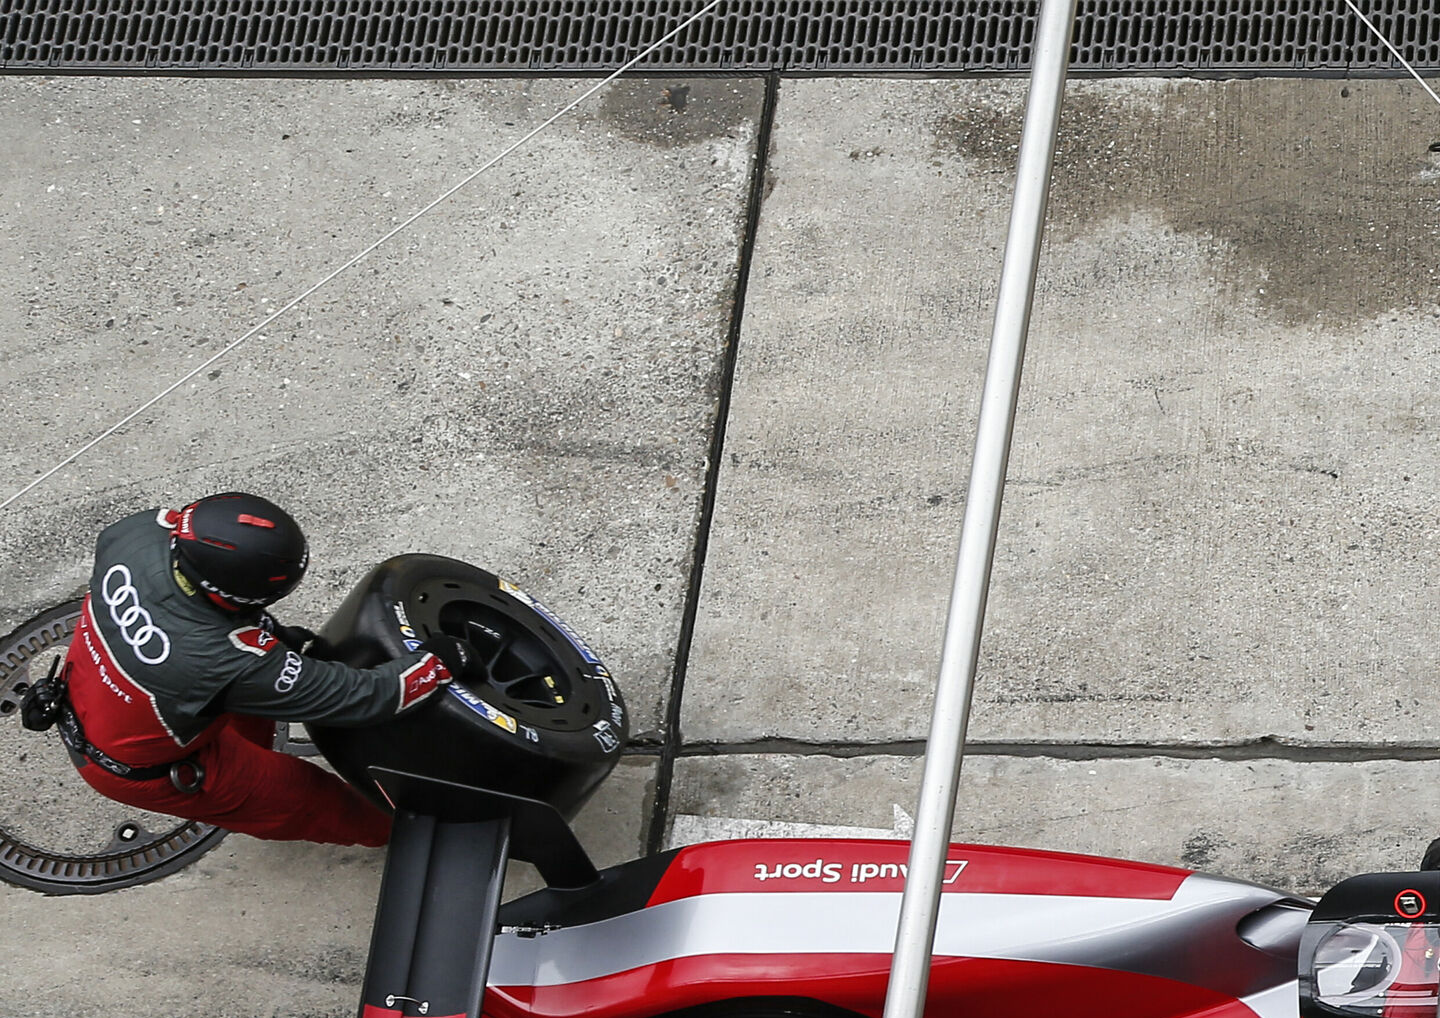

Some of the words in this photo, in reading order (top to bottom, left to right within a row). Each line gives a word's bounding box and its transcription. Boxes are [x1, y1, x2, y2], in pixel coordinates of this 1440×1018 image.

[200, 579, 268, 605] uvex
[98, 664, 133, 704] Sport
[753, 859, 844, 883] Sport
[850, 863, 909, 883] udi
